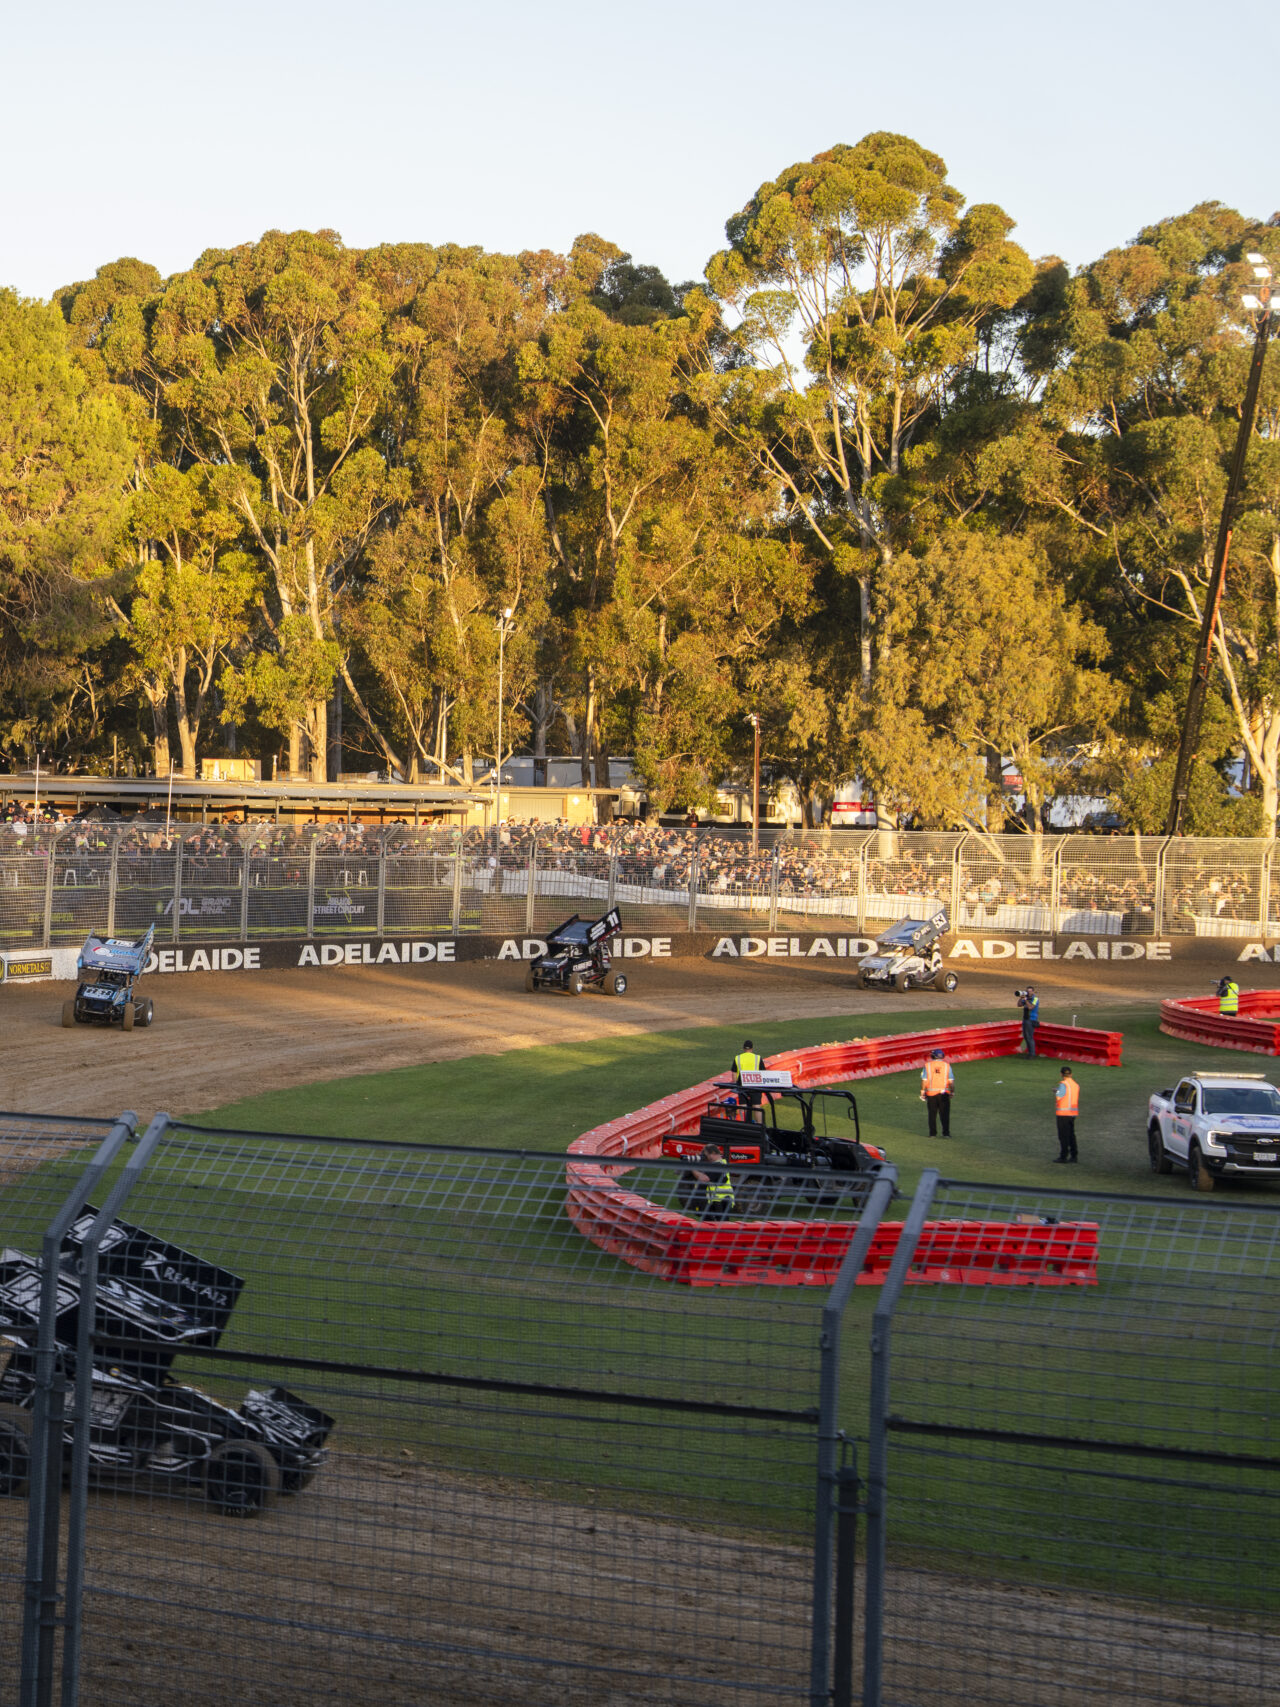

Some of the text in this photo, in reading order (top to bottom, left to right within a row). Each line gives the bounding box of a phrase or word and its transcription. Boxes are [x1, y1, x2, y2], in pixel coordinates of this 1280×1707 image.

[607, 911, 620, 927] 11
[297, 941, 456, 966] ADELAIDE
[712, 937, 879, 957] ADELAID
[948, 939, 1172, 961] ADELAIDE
[8, 962, 45, 975] NORMETALS
[144, 948, 261, 973] DELAIDE
[742, 1072, 762, 1085] KUB
[762, 1077, 780, 1085] power
[164, 1267, 228, 1306] REAL AIR
